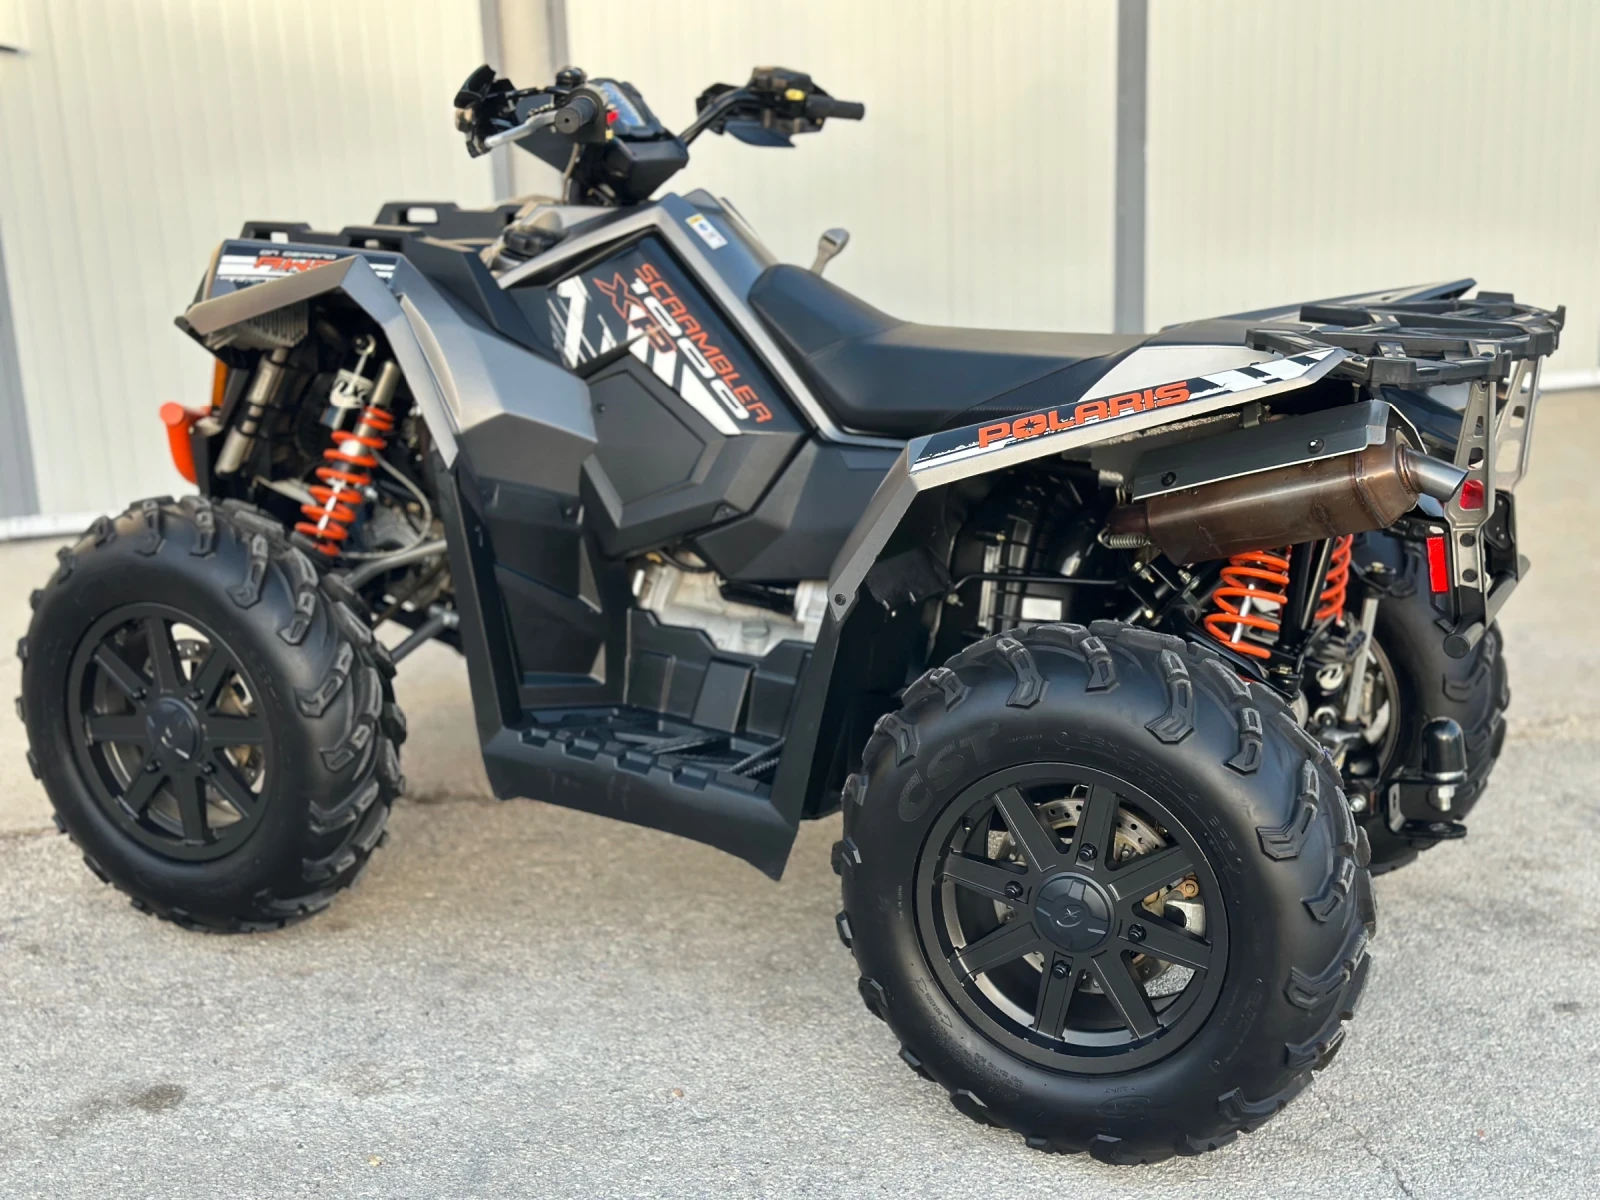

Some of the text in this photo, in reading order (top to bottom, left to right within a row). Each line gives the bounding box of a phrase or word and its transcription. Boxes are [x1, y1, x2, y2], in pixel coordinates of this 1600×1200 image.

[593, 272, 677, 354] XP
[630, 277, 750, 420] 1000
[634, 263, 773, 424] SCRAMBLER
[978, 381, 1191, 449] POLARIS
[898, 723, 999, 822] CST
